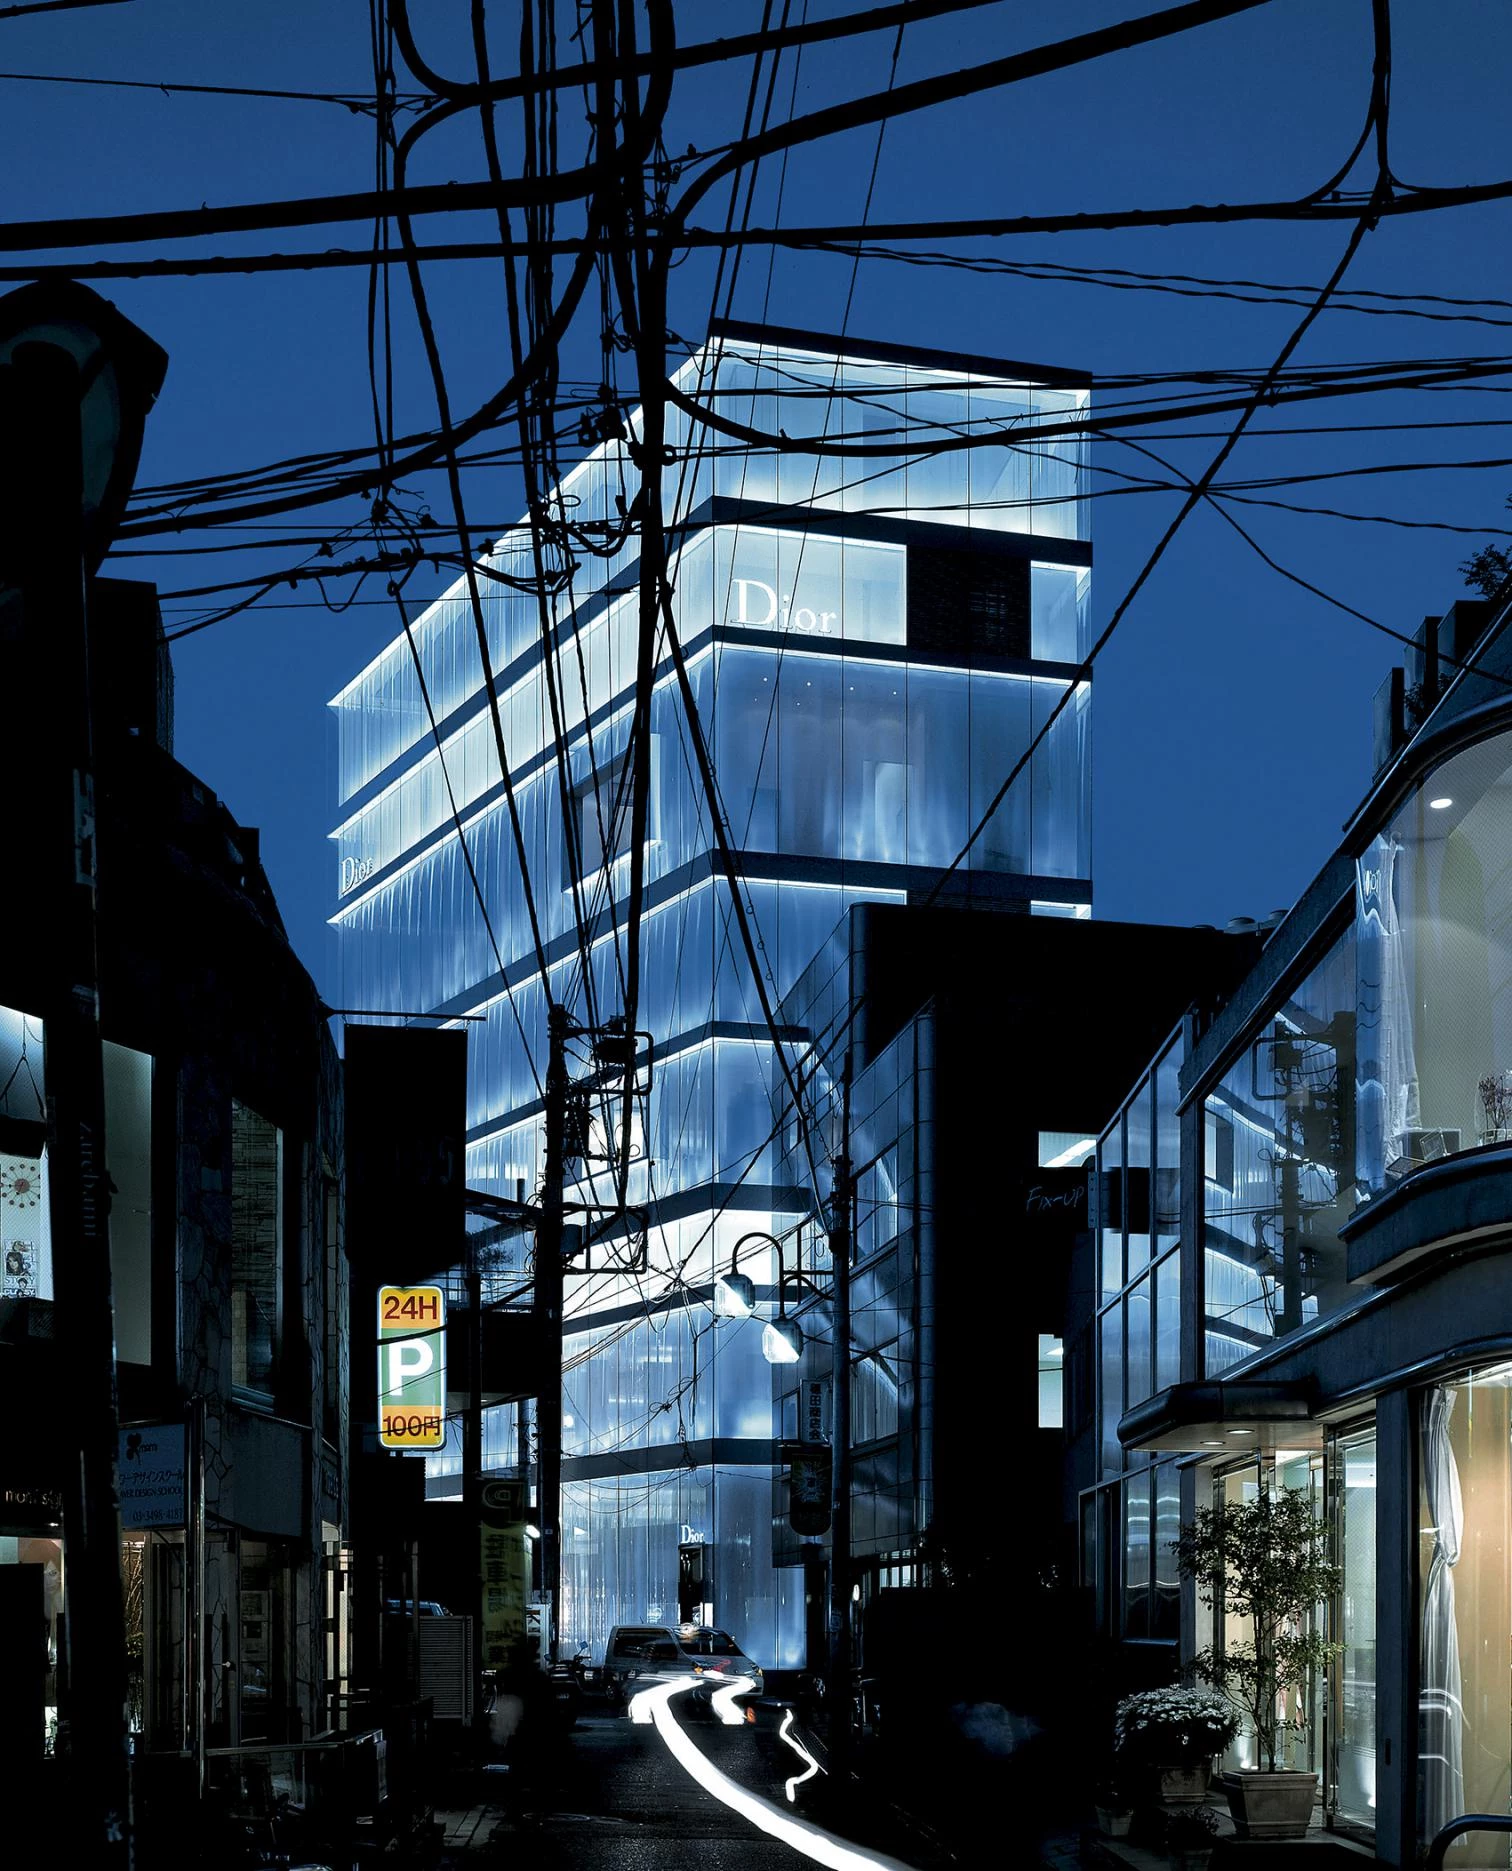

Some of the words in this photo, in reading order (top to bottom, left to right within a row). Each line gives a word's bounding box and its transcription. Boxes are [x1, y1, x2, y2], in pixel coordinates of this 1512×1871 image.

[729, 579, 837, 633] Dior
[341, 857, 373, 894] Dior
[384, 1296, 438, 1320] 24H
[388, 1338, 434, 1396] P
[383, 1415, 441, 1437] 100円
[680, 1524, 704, 1544] Dior
